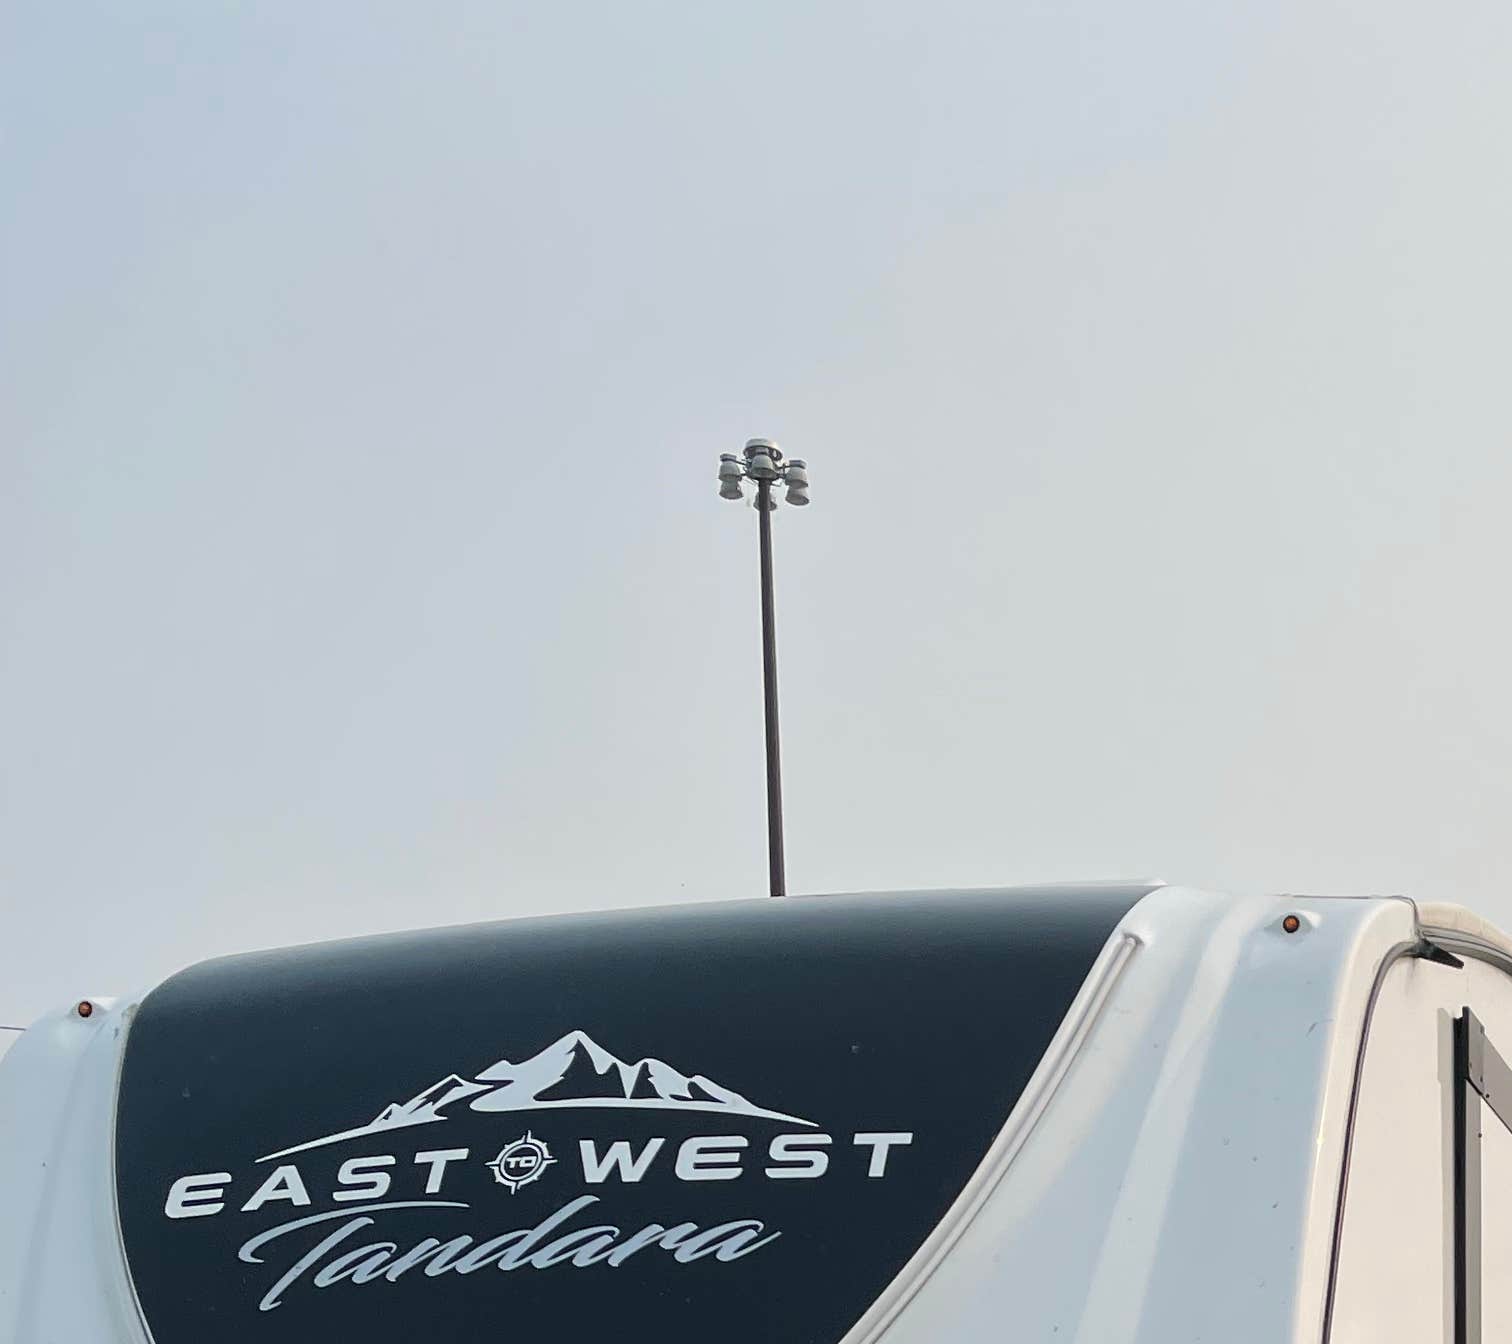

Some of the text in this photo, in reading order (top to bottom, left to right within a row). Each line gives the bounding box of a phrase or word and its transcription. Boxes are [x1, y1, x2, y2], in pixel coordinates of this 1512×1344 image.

[163, 1131, 914, 1220] EAST TO WEST
[238, 1195, 783, 1312] Tandara
